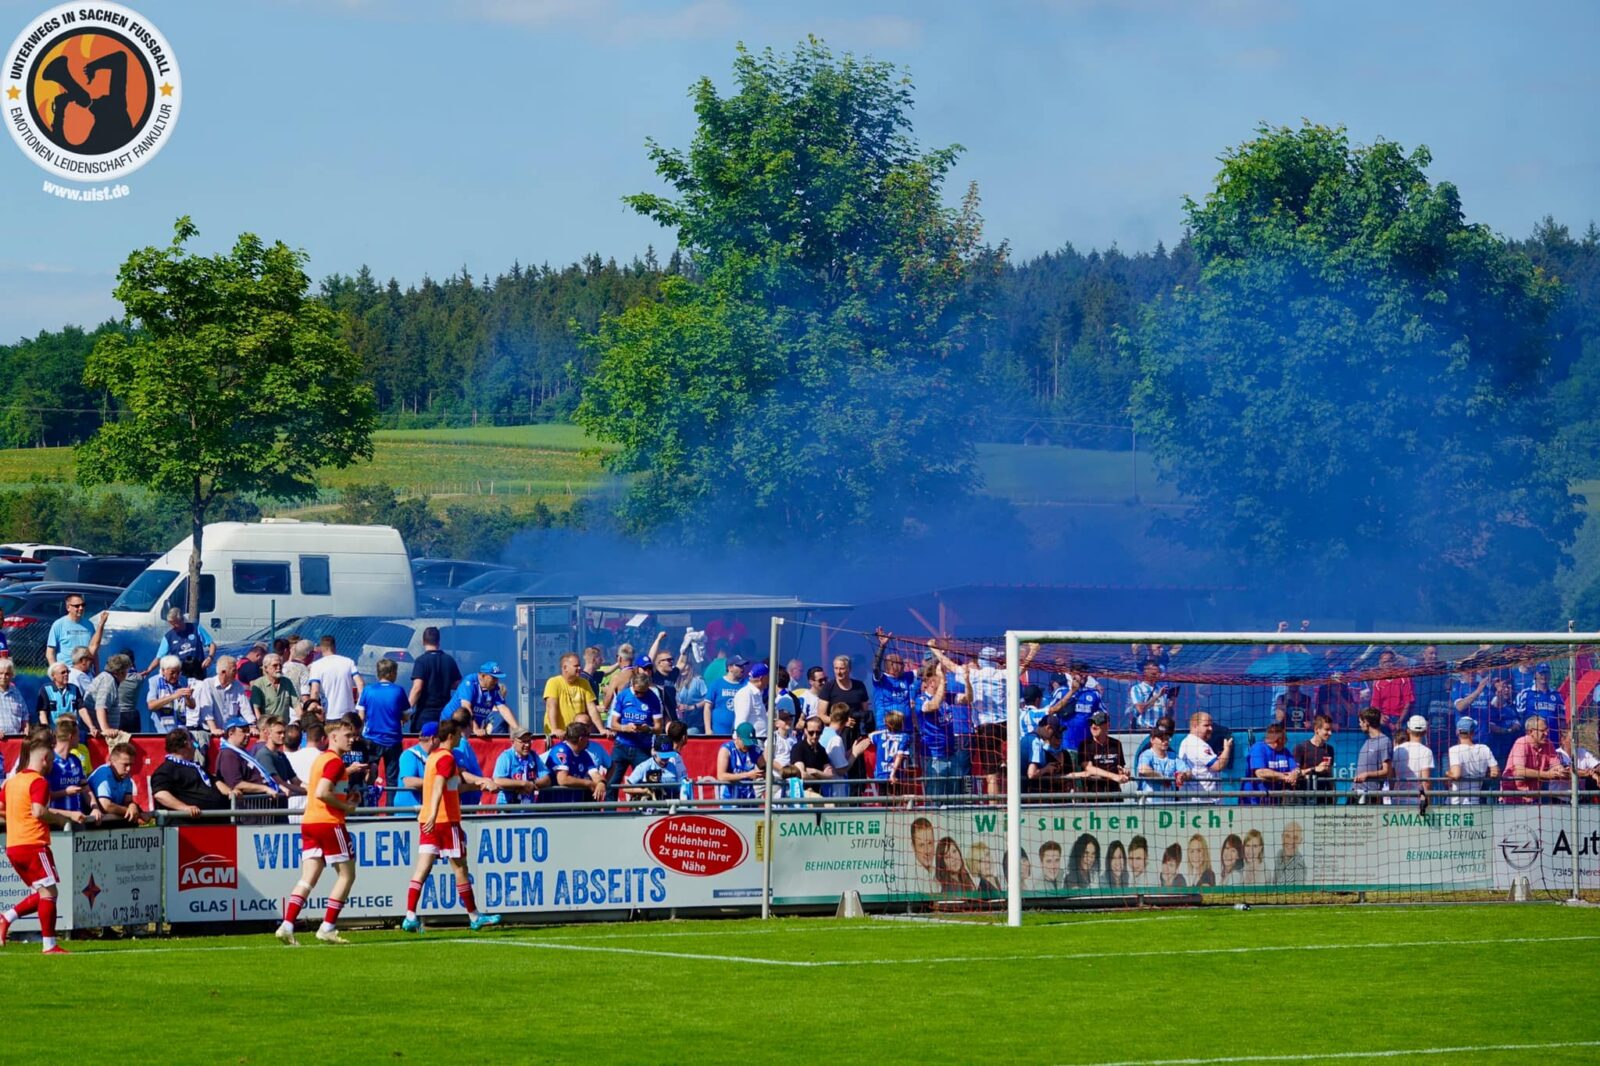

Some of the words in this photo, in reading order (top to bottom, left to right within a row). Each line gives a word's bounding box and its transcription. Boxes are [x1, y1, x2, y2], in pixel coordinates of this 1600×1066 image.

[974, 813, 1025, 832] Wi
[1038, 811, 1139, 831] suchen
[1159, 809, 1234, 829] Dich!
[1382, 813, 1460, 827] SAMARITER
[669, 821, 678, 831] In
[680, 823, 707, 834] Aalen
[709, 828, 727, 837] und
[779, 820, 865, 837] SAMARITER
[75, 833, 118, 852] Pizzeria
[121, 833, 159, 852] Europa
[477, 826, 548, 864] AUTO
[664, 833, 720, 849] Heidenheim
[850, 838, 895, 849] STIFTUNG
[659, 846, 670, 856] 2x
[672, 849, 694, 859] ganz
[697, 849, 705, 860] in
[707, 851, 732, 863] Ihrer
[1406, 850, 1486, 860] BEHINDERTENHILFE
[681, 860, 706, 873] Nähe
[805, 859, 895, 871] BEHINDERTENHILFE
[181, 867, 235, 884] AGM
[485, 870, 544, 907] DEM
[553, 866, 666, 906] ABSEITS
[189, 900, 228, 913] GLAS
[240, 898, 278, 912] LACK
